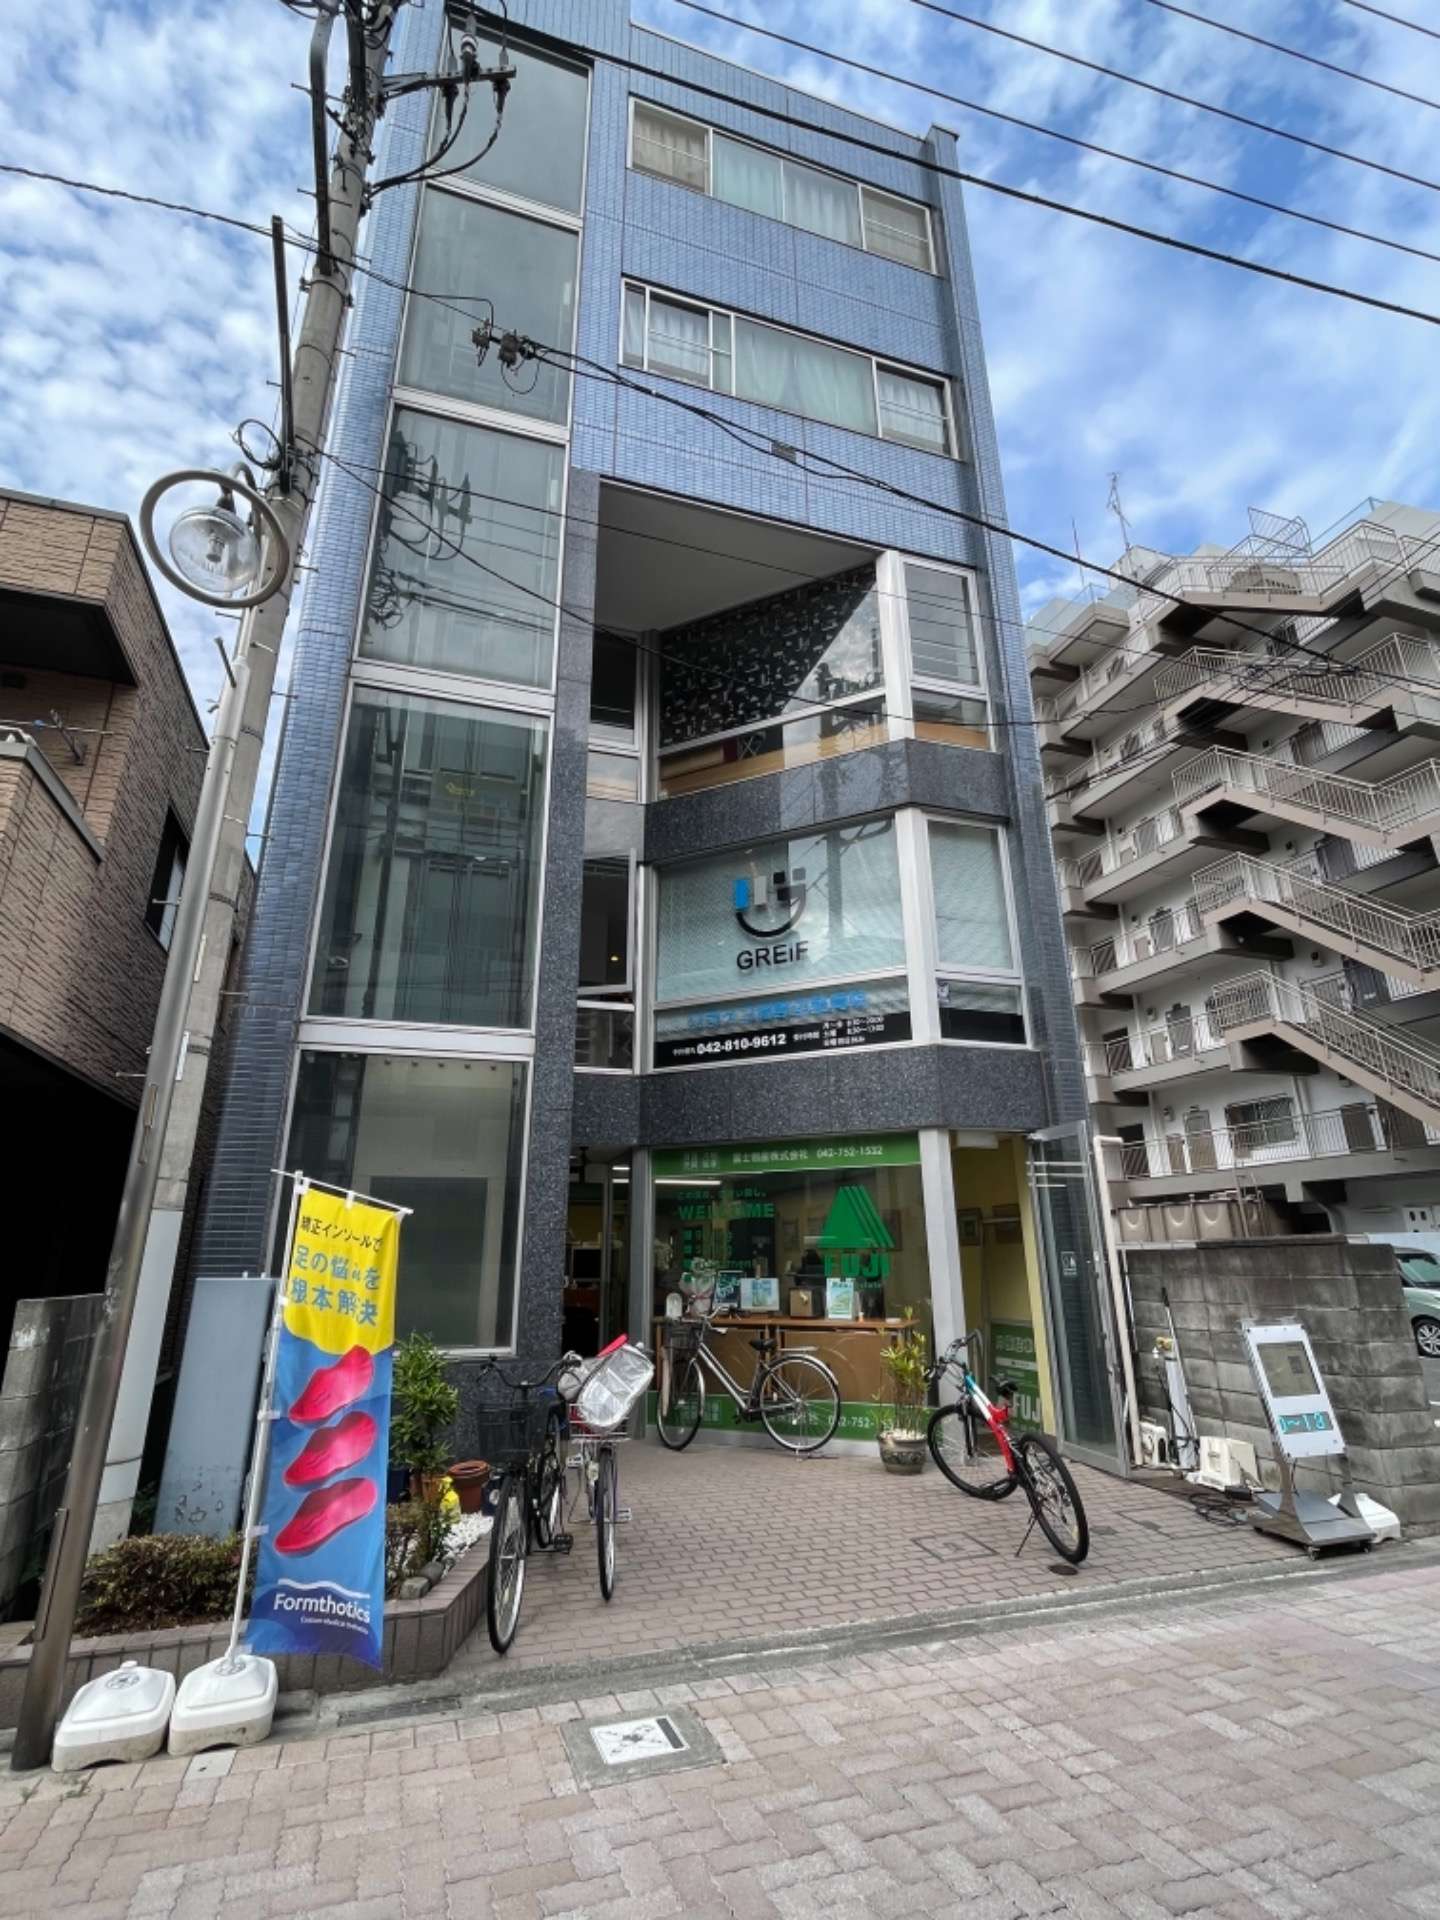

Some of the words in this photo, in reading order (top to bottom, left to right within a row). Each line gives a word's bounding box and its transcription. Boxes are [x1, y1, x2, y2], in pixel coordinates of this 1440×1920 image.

[696, 1034, 786, 1055] 042-810-9612
[679, 1202, 776, 1220] WELOME
[824, 1252, 891, 1280] FUJI
[291, 1277, 378, 1326] 根本解決
[273, 1593, 370, 1623] Formthotics
